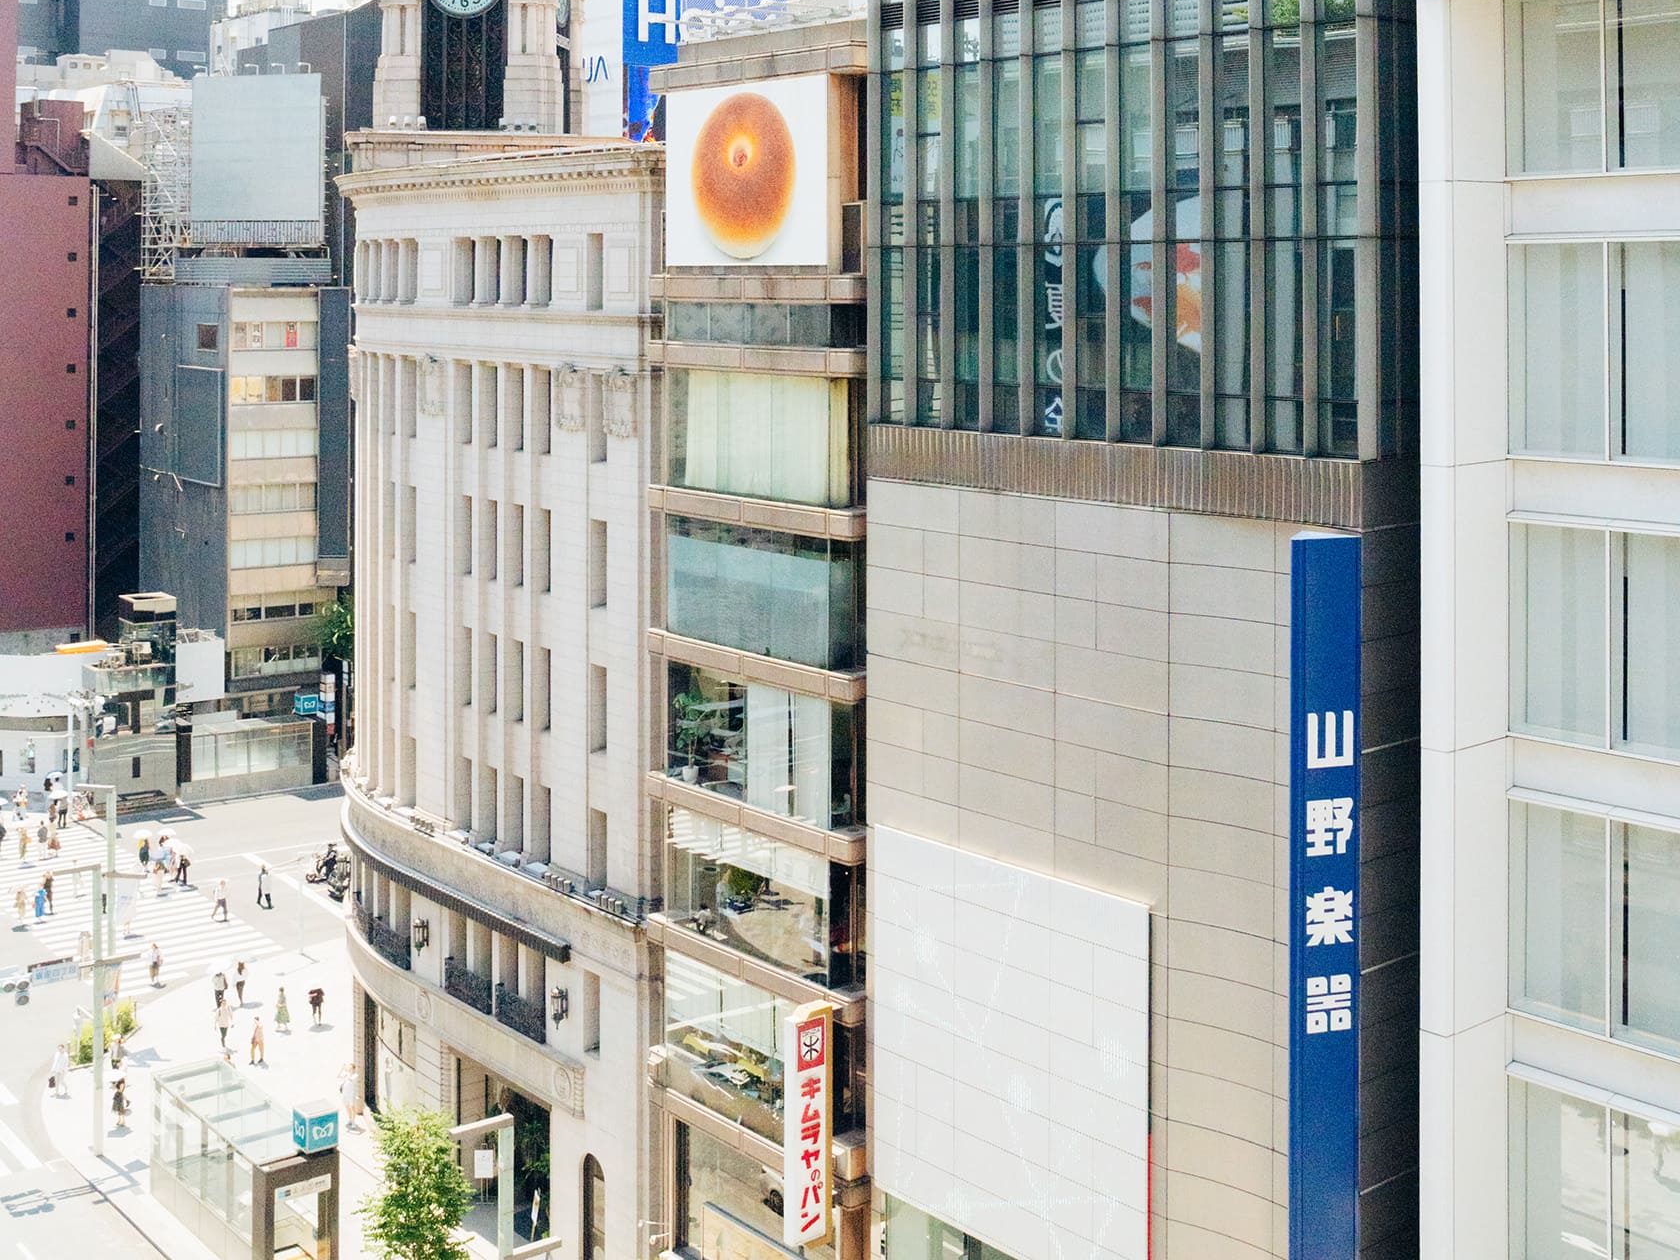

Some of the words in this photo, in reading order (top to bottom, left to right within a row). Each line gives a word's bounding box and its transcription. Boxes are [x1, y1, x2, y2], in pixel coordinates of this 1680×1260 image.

[1306, 709, 1355, 1034] 山野楽器
[800, 1077, 824, 1233] キムラヤのパン
